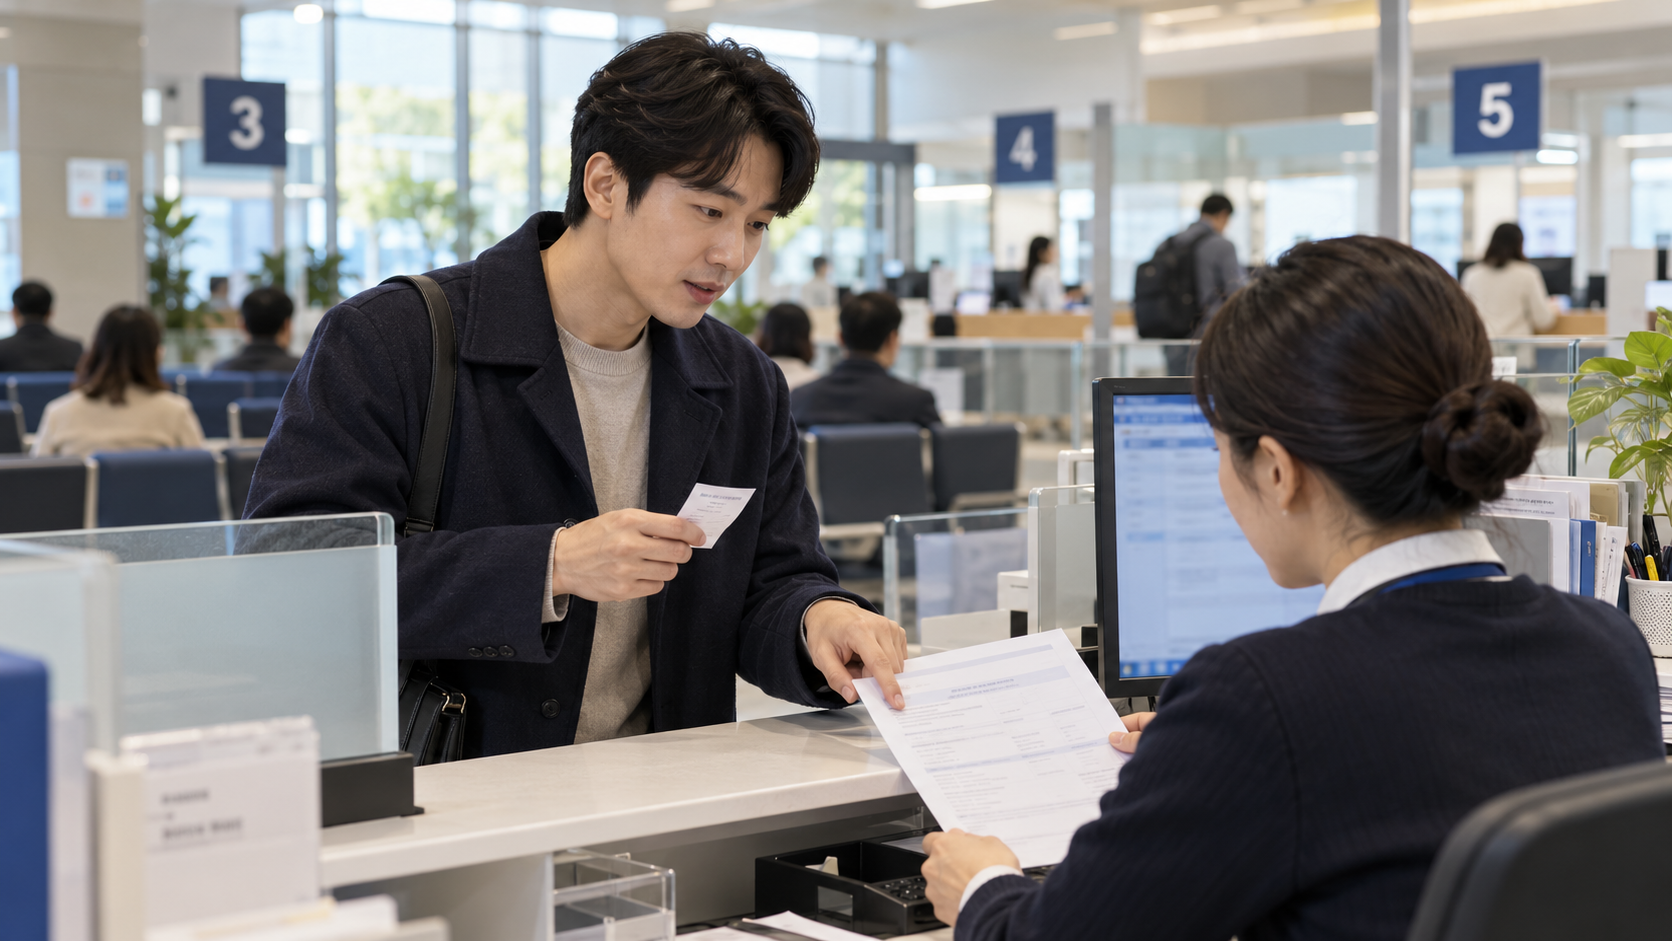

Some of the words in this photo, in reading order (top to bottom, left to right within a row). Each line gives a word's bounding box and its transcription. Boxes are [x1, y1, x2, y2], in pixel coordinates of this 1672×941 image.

[229, 96, 264, 149] 3
[1478, 82, 1514, 138] 5
[1010, 127, 1037, 171] 4
